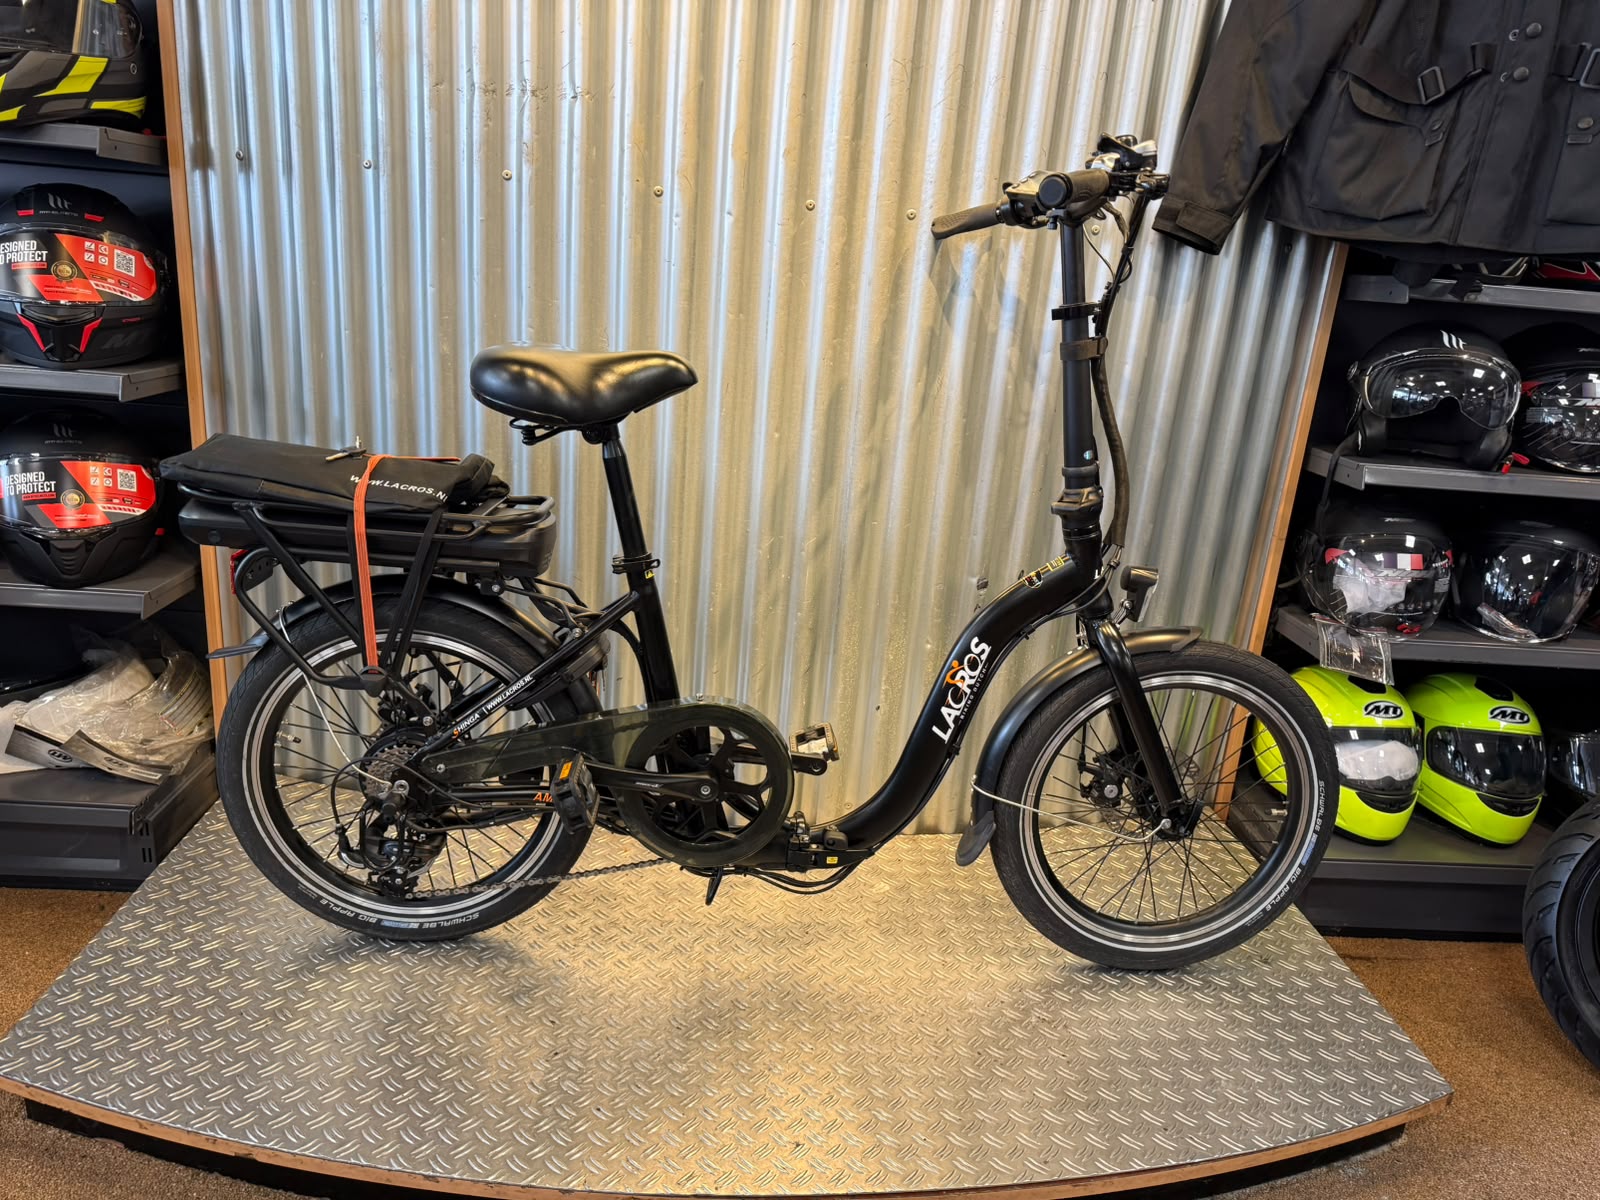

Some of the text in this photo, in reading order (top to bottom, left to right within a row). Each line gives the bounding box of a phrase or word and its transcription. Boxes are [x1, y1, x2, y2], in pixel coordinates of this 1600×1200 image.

[0, 240, 37, 253] ESIGNED
[6, 251, 48, 263] PROTECT
[5, 471, 45, 486] DESIGNED
[5, 480, 56, 496] TO PROTECT
[350, 474, 448, 502] WW.LACROS.N
[932, 636, 991, 743] LACROS
[973, 667, 987, 692] DUTCH
[486, 675, 534, 712] WWW.LACROS.NL
[1314, 780, 1325, 831] SCHWALBE
[1266, 884, 1290, 911] APPLE
[320, 898, 356, 918] APPLE
[358, 915, 377, 923] BIG
[422, 912, 480, 929] SCHWALBE
